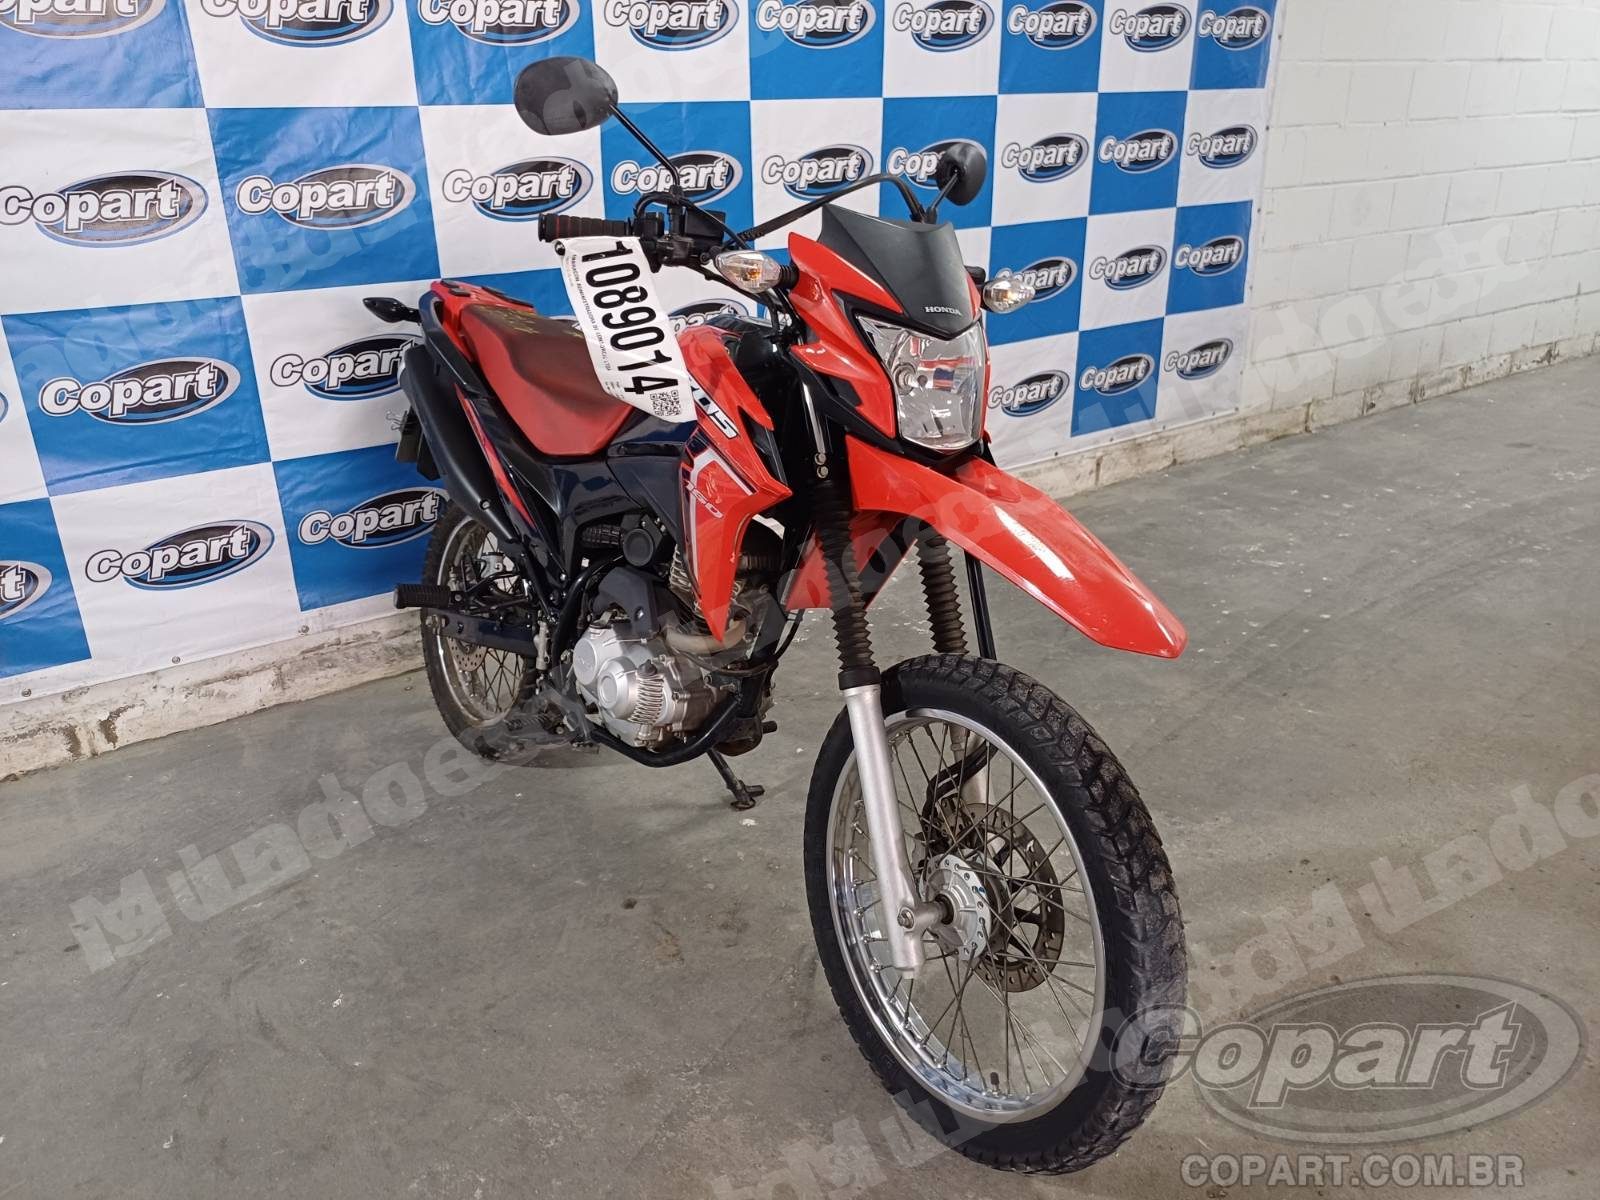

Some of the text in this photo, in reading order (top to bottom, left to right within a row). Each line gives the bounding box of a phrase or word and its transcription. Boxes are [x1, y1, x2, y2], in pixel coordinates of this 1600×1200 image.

[418, 0, 561, 34] Copart
[604, 0, 723, 37] Copart
[756, 1, 863, 38] Copart
[893, 2, 983, 40] Copart
[1007, 4, 1090, 41] Copart
[1110, 9, 1184, 42] Copart
[1198, 10, 1263, 43] Copart
[1001, 141, 1082, 174] Copart
[1098, 134, 1171, 167] Copart
[1186, 132, 1252, 158] Copart
[761, 151, 862, 190] Copart
[886, 147, 946, 182] Cop
[236, 171, 397, 220] Copart
[442, 165, 580, 207] Copart
[0, 178, 182, 233] Copart
[1089, 251, 1159, 283] Copart
[1175, 241, 1239, 272] Copart
[581, 241, 679, 395] 1089014
[924, 306, 963, 317] HONDA
[1080, 359, 1147, 391] Copart
[1164, 343, 1229, 373] Copart
[38, 362, 219, 418] Copart
[988, 374, 1064, 411] Copart
[299, 491, 439, 545] Copart
[85, 525, 252, 583] Copart
